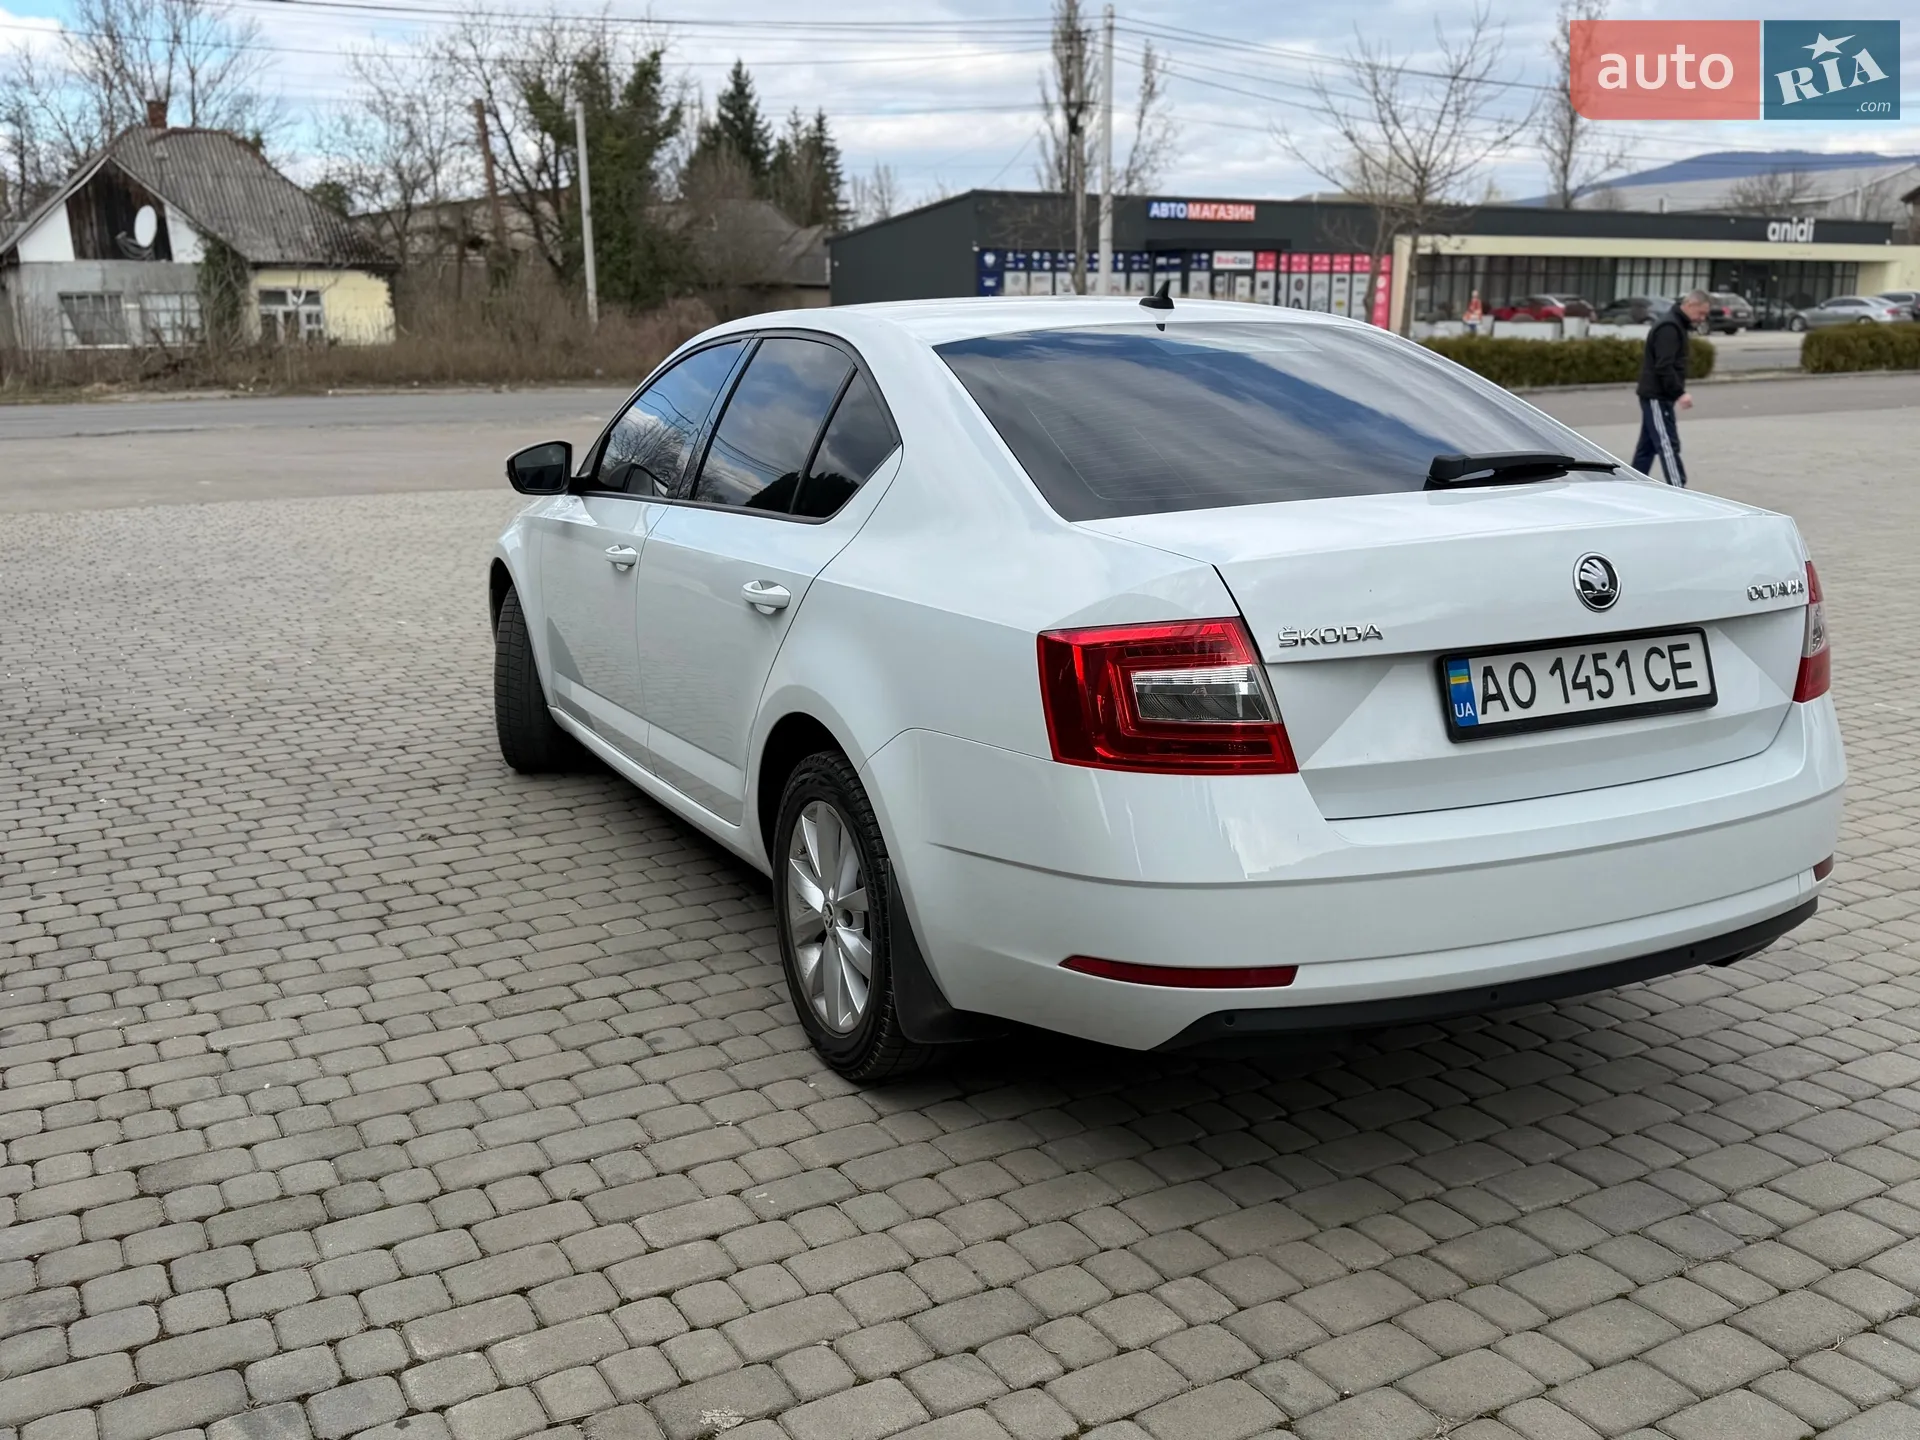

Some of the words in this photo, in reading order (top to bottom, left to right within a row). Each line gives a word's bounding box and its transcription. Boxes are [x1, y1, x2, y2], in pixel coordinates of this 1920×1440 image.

[1149, 202, 1256, 220] АВТОМАГАЗИН
[1767, 216, 1815, 242] anidi
[1747, 579, 1804, 601] OCTAVIA
[1278, 623, 1383, 648] ŠKODA
[1481, 661, 1536, 715] AO
[1549, 650, 1636, 704] 1451
[1644, 643, 1698, 692] CE
[1454, 701, 1475, 718] UA
